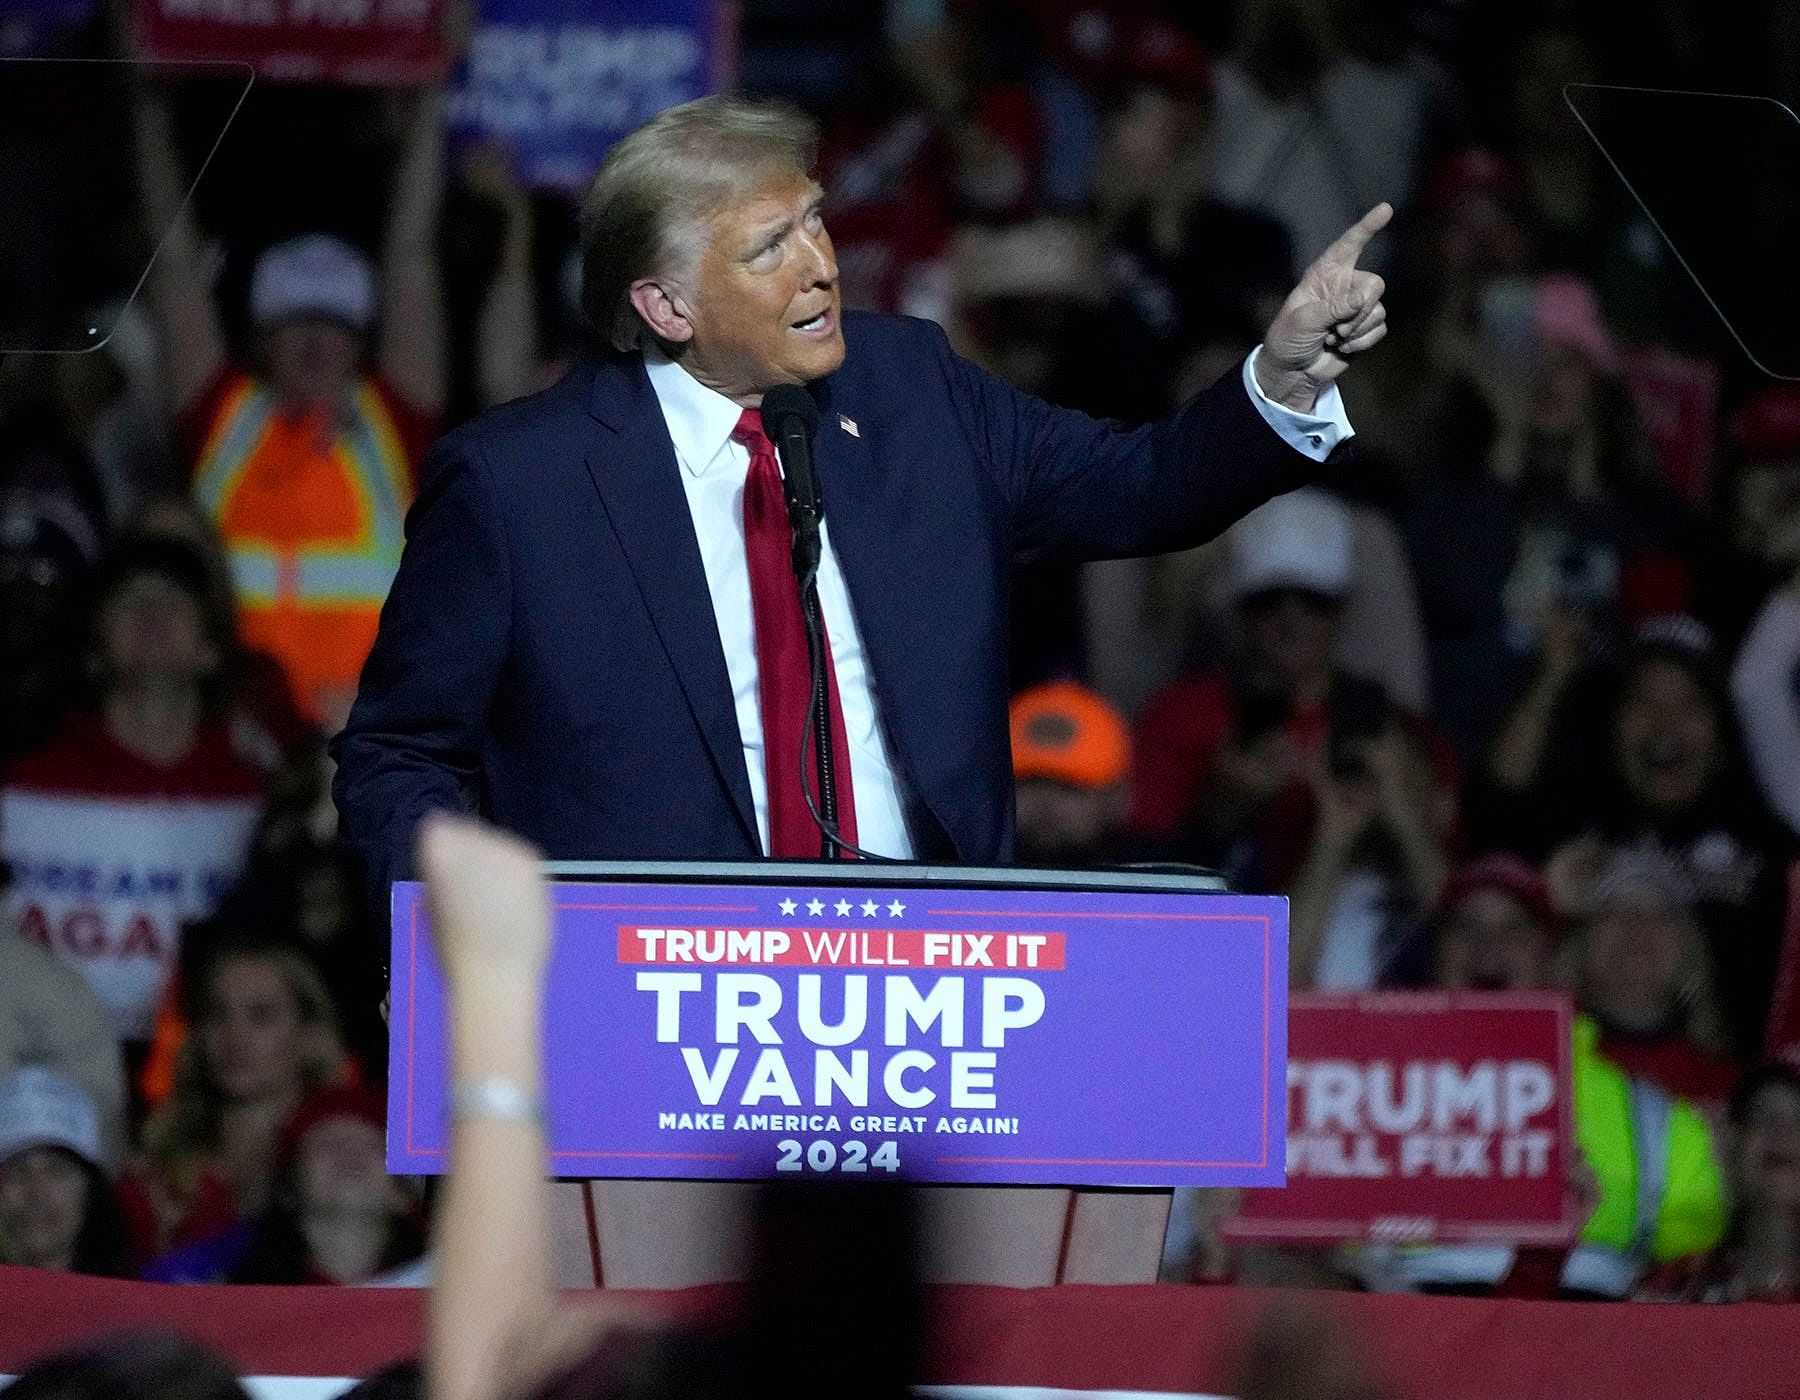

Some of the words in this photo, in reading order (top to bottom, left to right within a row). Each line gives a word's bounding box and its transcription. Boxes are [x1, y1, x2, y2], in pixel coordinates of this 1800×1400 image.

[637, 929, 791, 963] TRUMP
[802, 932, 909, 966] WILL
[924, 934, 993, 967] FIX
[1007, 935, 1046, 967] IT
[636, 972, 1046, 1048] TRUMP
[681, 1047, 997, 1109] VANCE
[658, 1112, 725, 1131] MAKE
[733, 1113, 841, 1132] AMERICA
[851, 1115, 927, 1133] GREAT
[935, 1116, 1019, 1135] AGAIN!
[776, 1139, 900, 1173] 2024
[1400, 1132, 1491, 1178] FIX
[1501, 1129, 1553, 1178] IT
